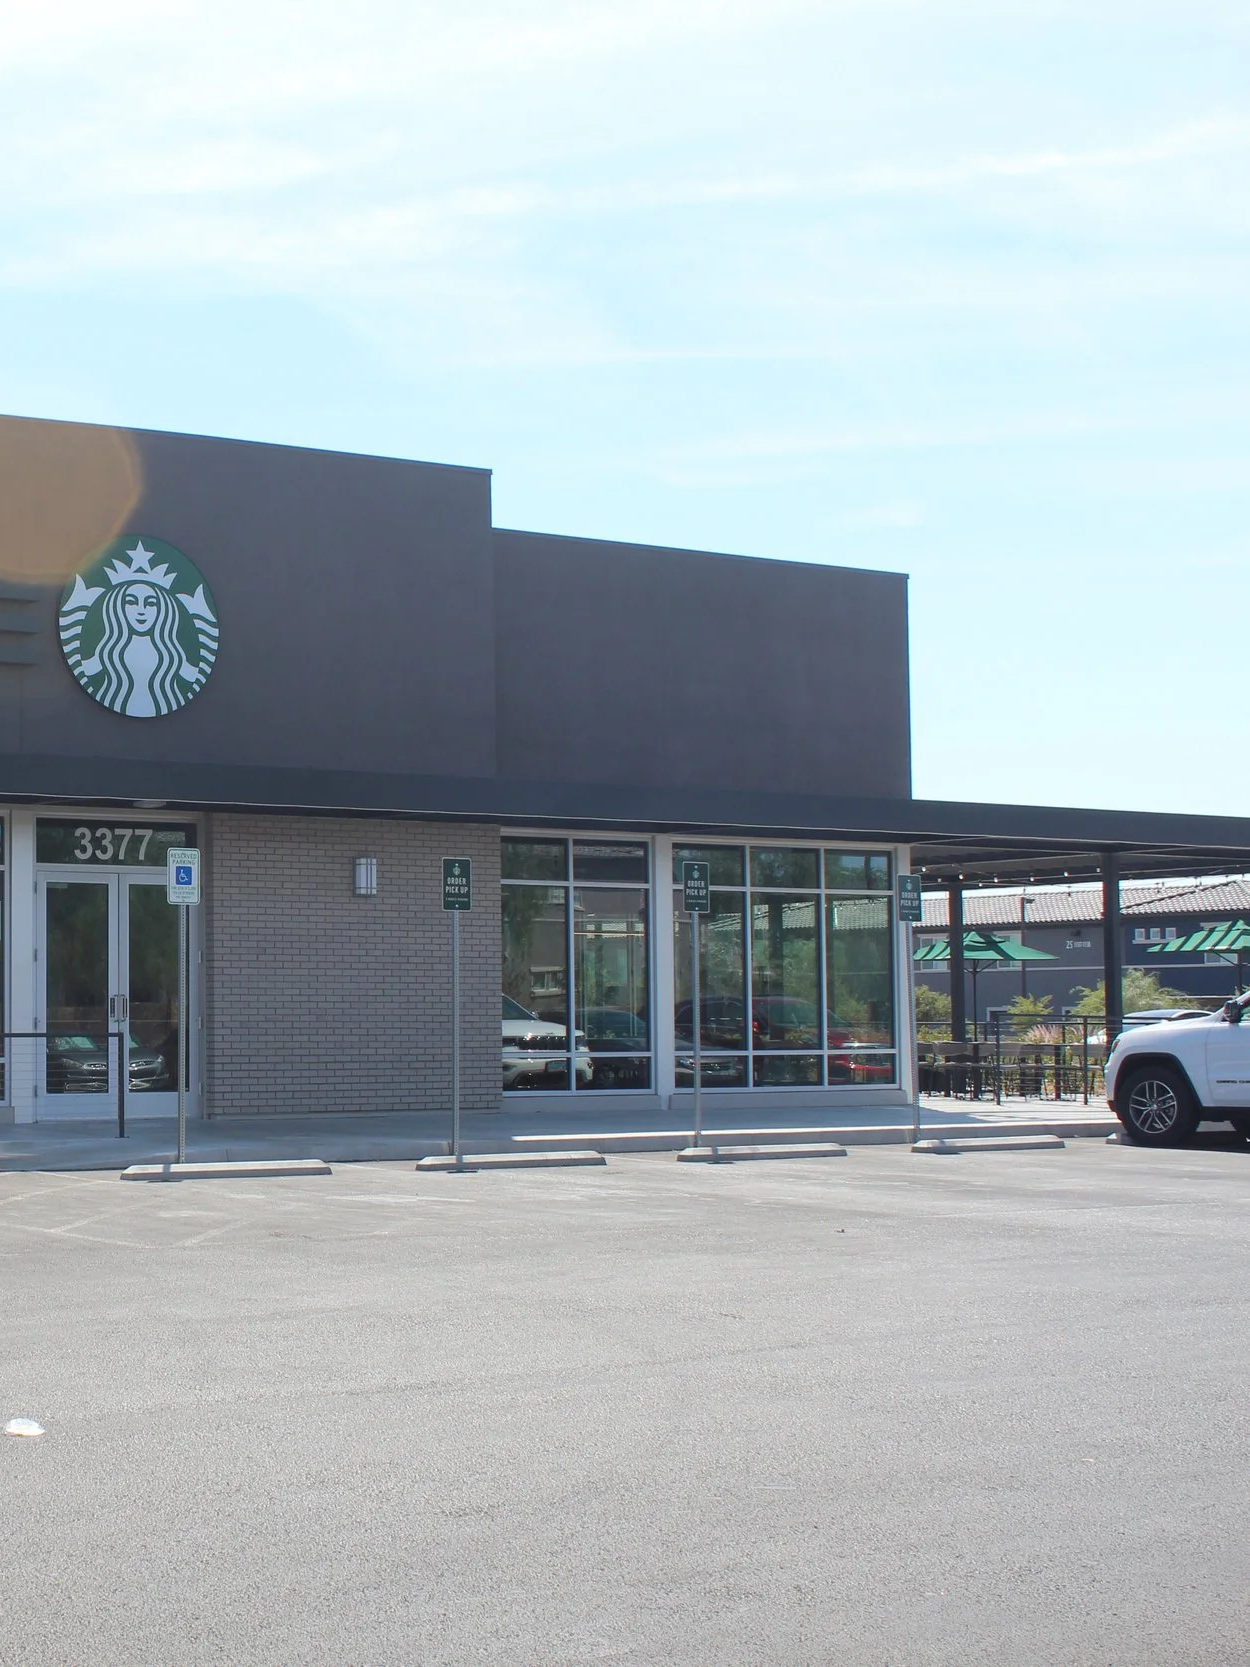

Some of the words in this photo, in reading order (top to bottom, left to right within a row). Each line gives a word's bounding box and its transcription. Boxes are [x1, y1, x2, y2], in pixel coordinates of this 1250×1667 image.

[74, 827, 153, 860] 3377
[447, 877, 467, 885] ORDER
[687, 880, 705, 888] ORDER
[445, 886, 459, 894] PICK
[686, 888, 699, 896] PICK
